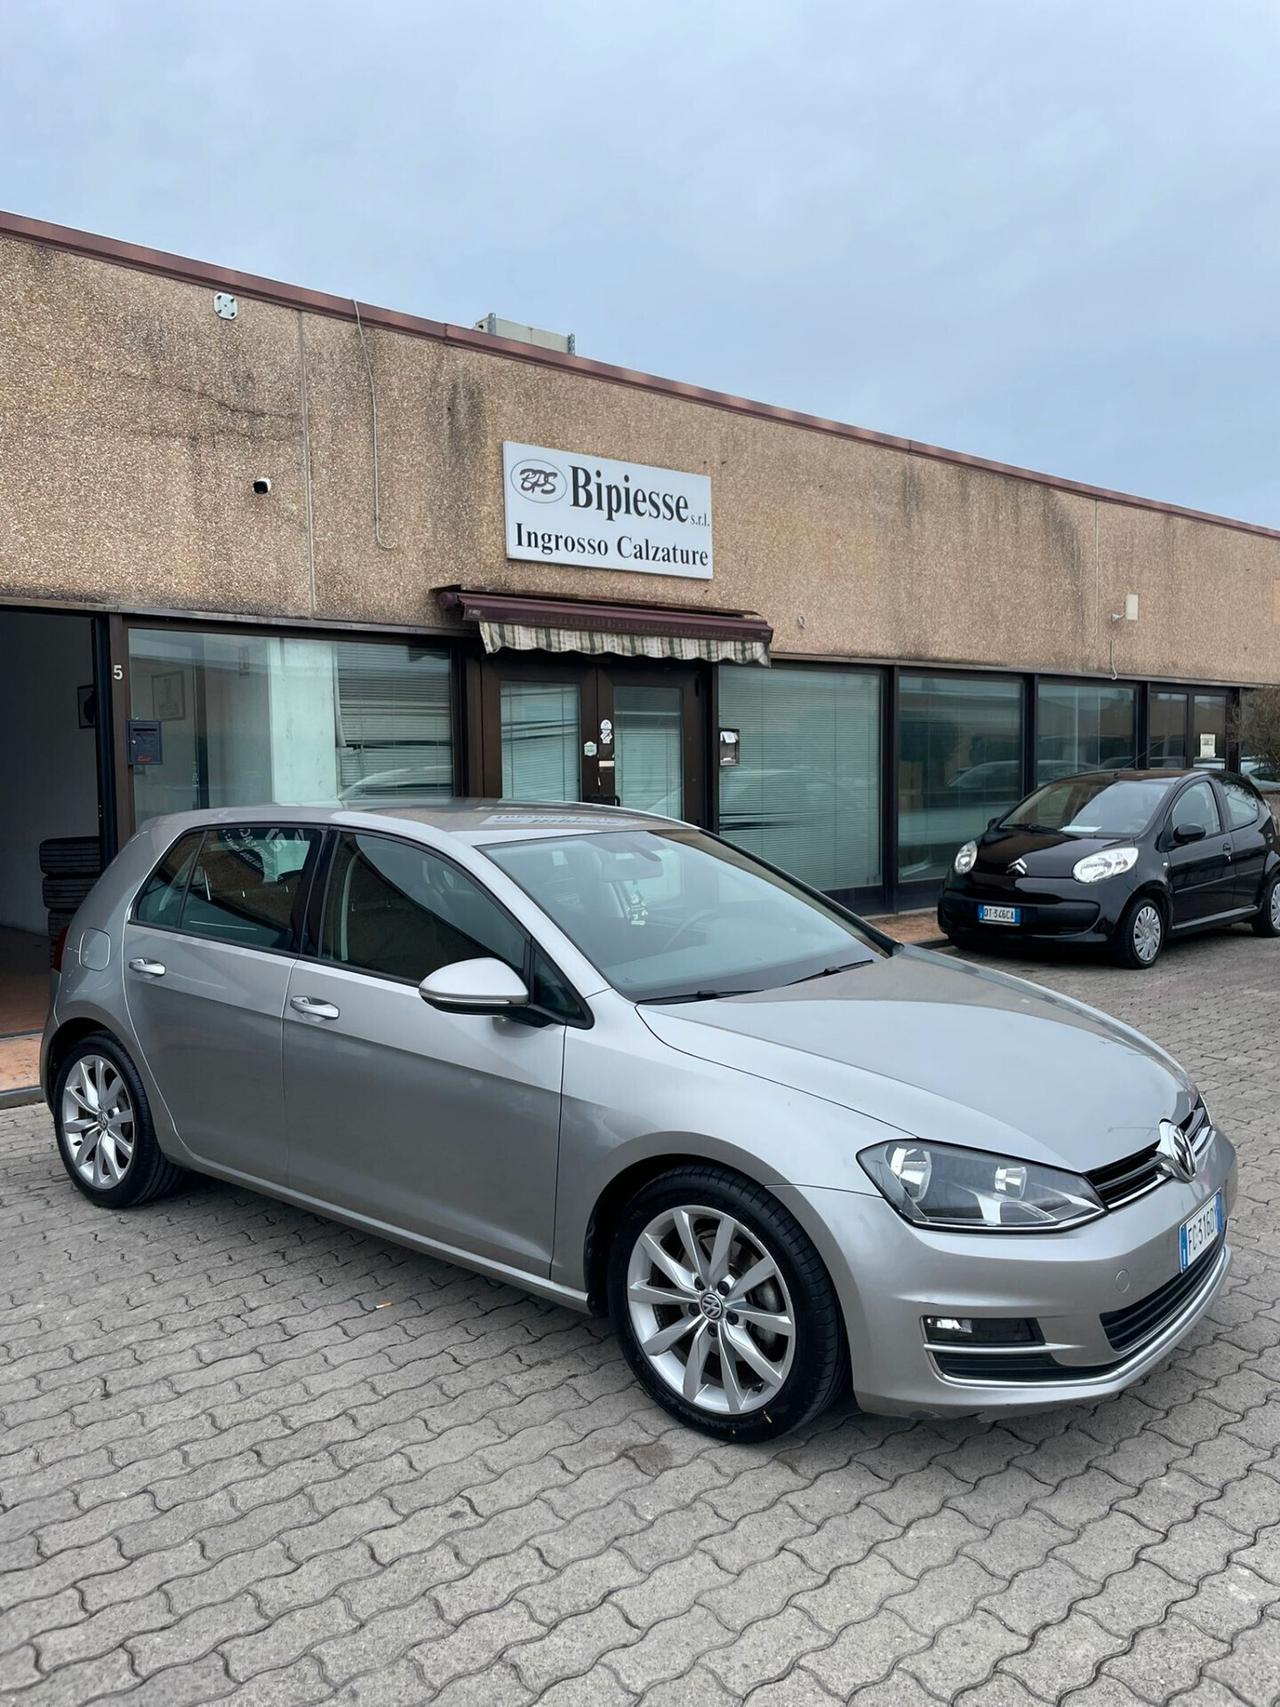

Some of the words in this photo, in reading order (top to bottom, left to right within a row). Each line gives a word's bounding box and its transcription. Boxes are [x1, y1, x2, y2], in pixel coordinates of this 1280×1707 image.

[569, 465, 689, 522] Bipiesse
[690, 513, 710, 527] s.r.l.
[515, 523, 608, 556] Ingrosso
[617, 535, 709, 566] Calzature
[113, 665, 123, 680] 5
